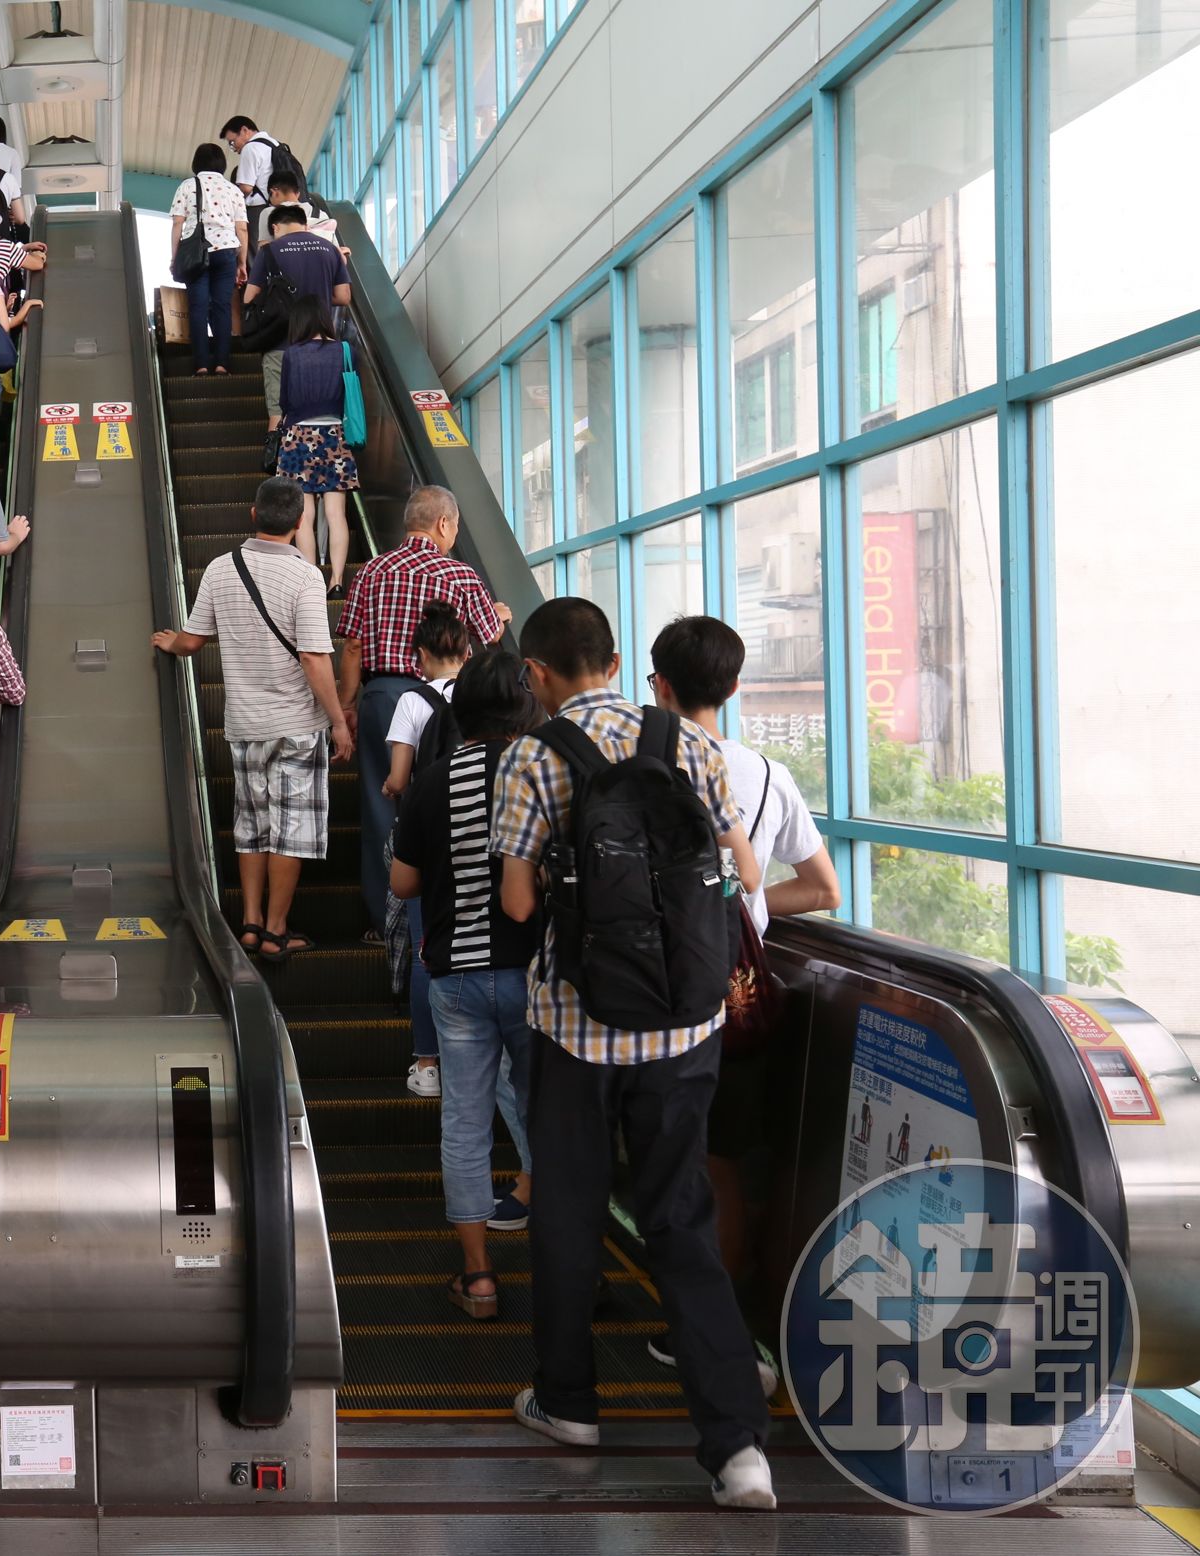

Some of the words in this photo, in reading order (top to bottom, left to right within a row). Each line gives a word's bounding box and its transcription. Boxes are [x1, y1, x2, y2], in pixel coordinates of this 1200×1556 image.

[862, 525, 900, 633] Lena
[865, 648, 904, 732] Hair
[999, 1468, 1011, 1492] 1
